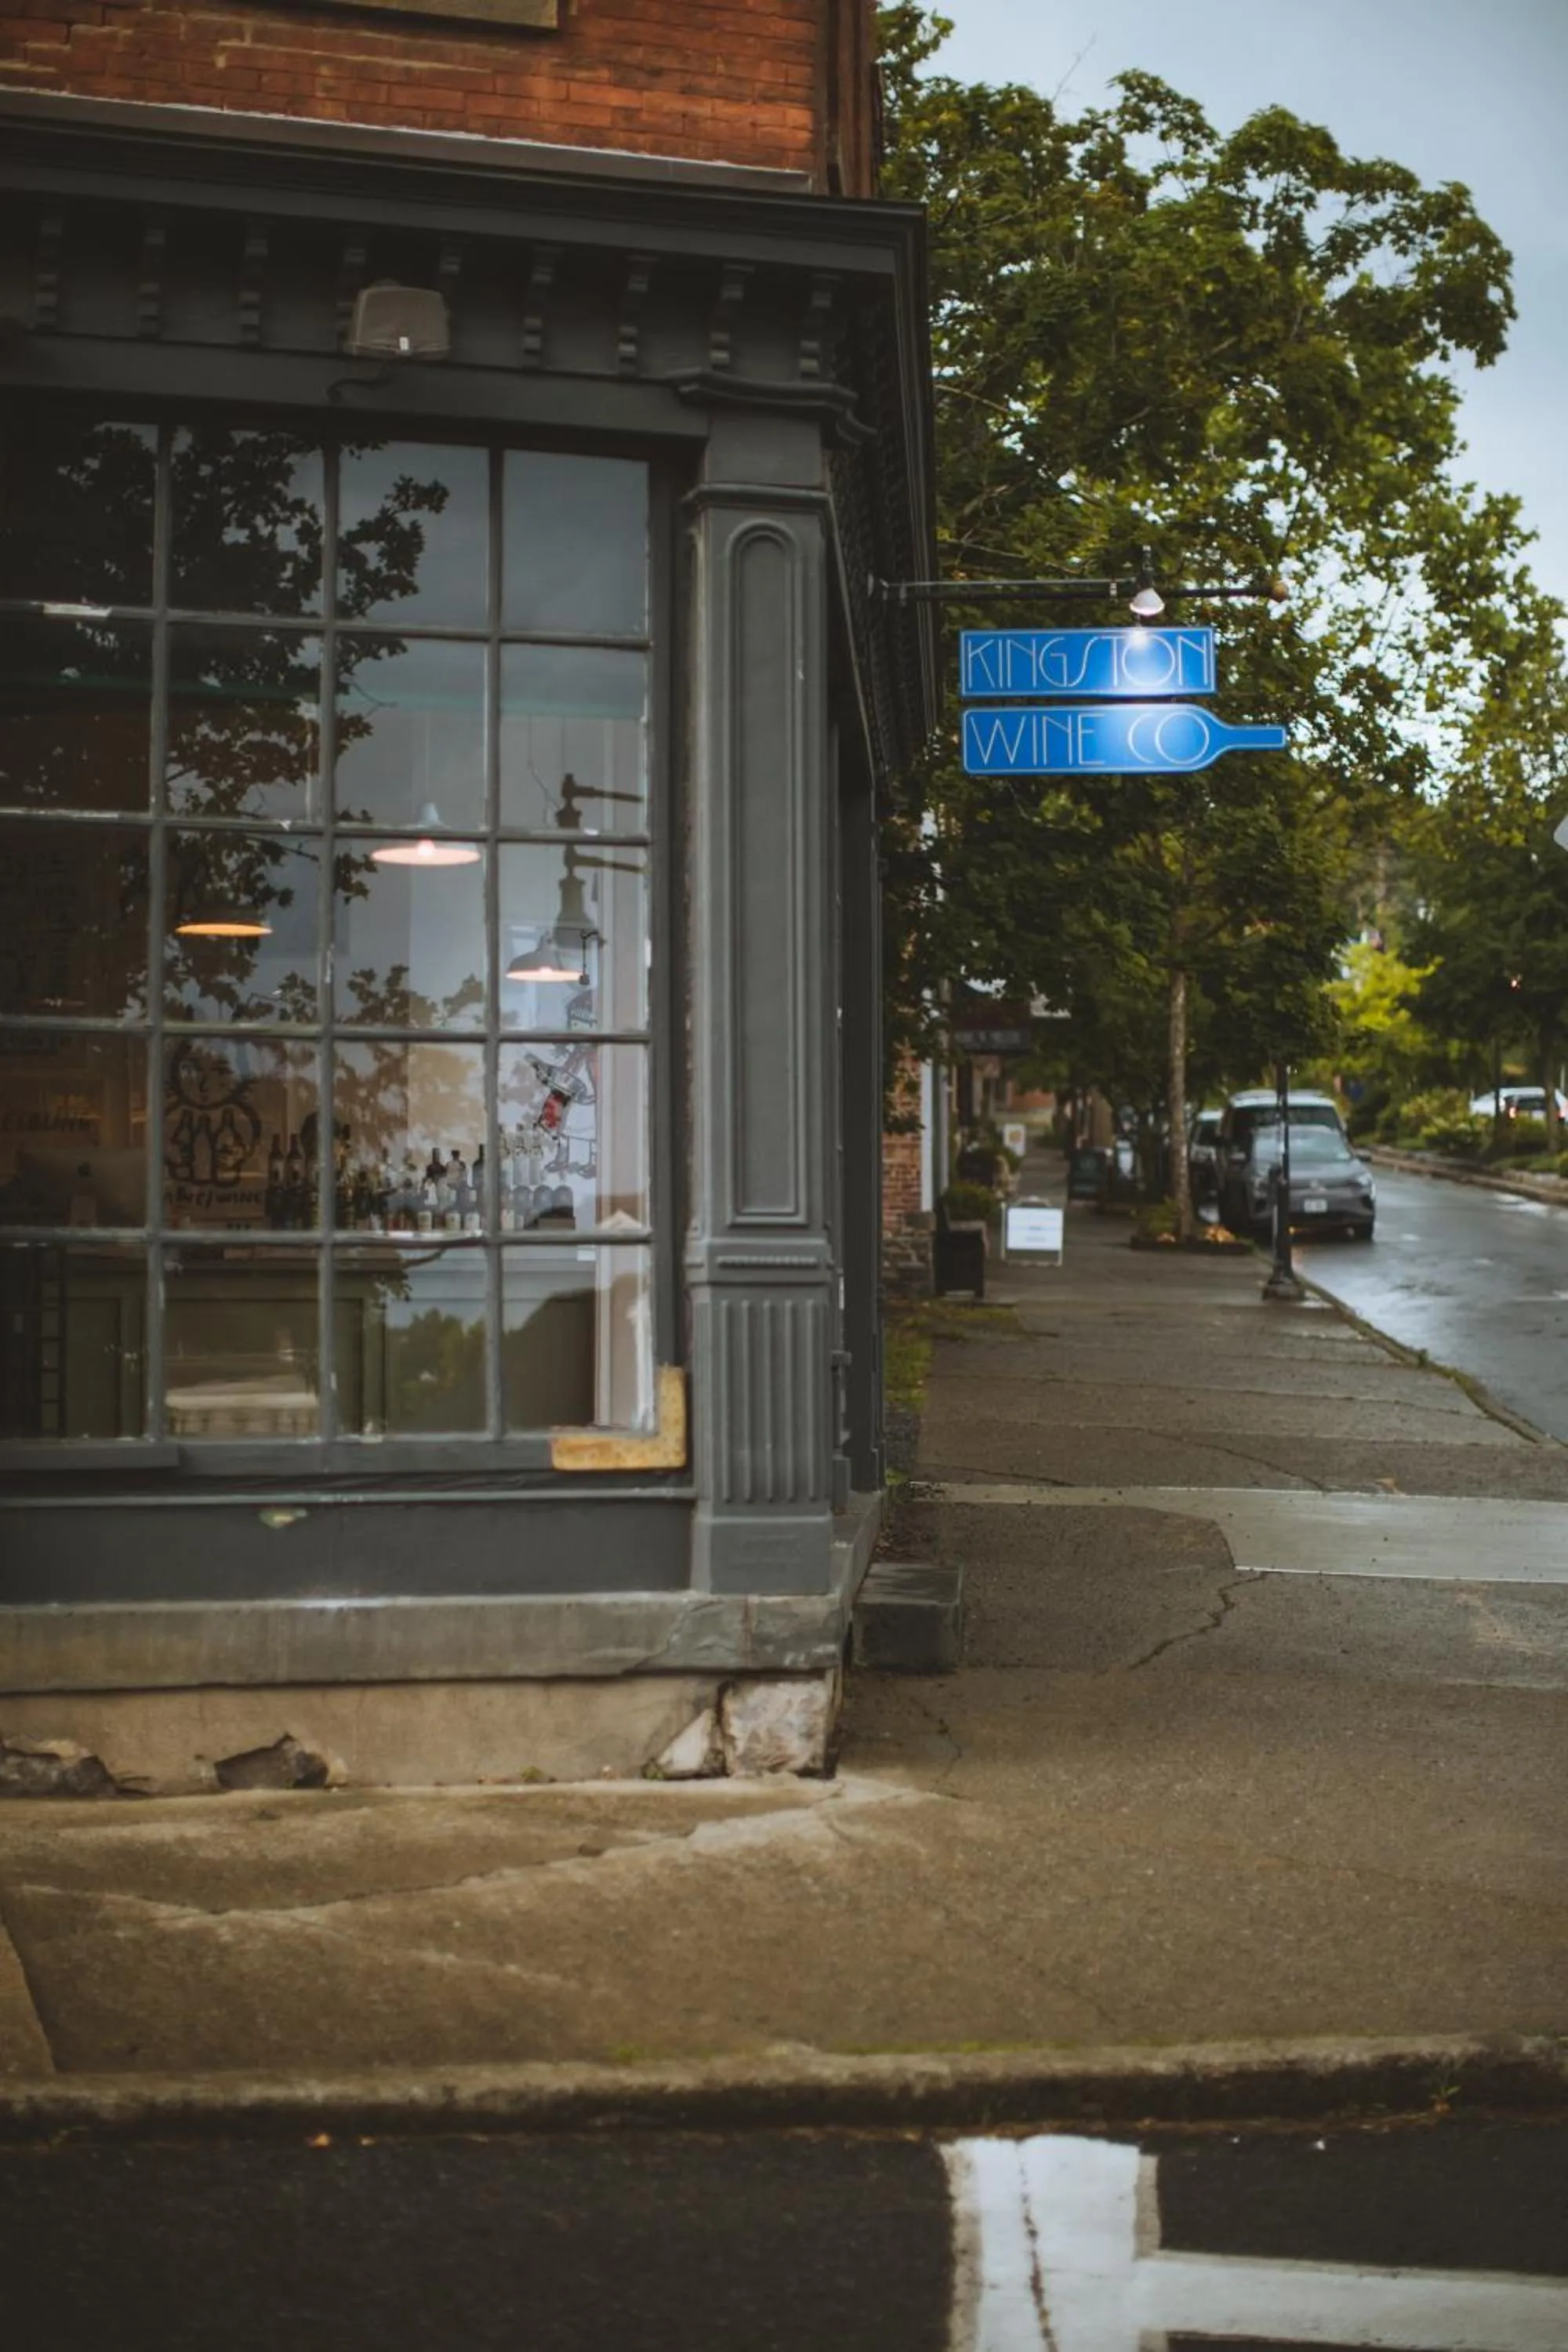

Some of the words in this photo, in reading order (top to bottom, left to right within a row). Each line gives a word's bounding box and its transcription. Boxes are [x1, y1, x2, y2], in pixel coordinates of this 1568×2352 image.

[967, 633, 1208, 689] KINGSTON
[969, 713, 1105, 766] WINE
[1127, 710, 1210, 765] CO
